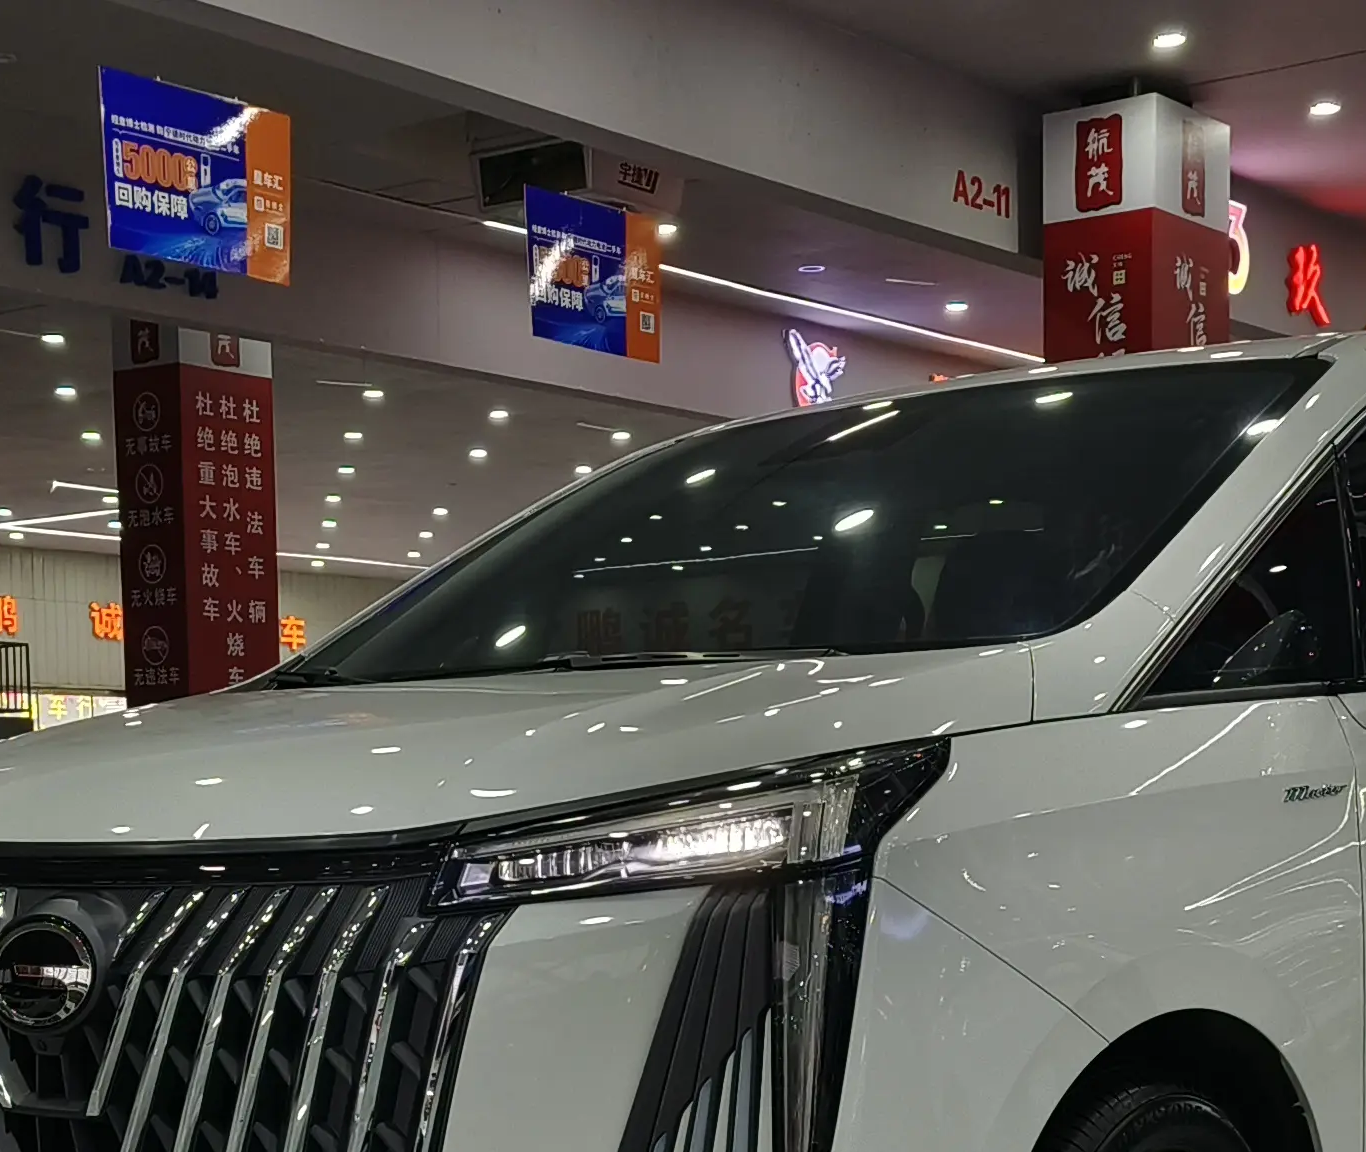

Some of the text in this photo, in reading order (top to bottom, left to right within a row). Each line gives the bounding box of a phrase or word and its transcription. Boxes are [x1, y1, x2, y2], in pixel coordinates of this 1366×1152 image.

[1084, 127, 1115, 199] 航茂
[115, 182, 189, 220] 回购保障
[952, 169, 1010, 219] A2-11
[1061, 251, 1127, 358] 诚信
[125, 433, 173, 457] 无事故车
[127, 505, 175, 529] 无泡水车
[195, 390, 221, 622] 杜绝重大事故车
[243, 398, 267, 624] 杜绝违法车辆
[219, 394, 246, 688] 杜绝泡水车、火烧车
[130, 587, 178, 608] 无火烧车
[133, 667, 180, 687] 无违法车
